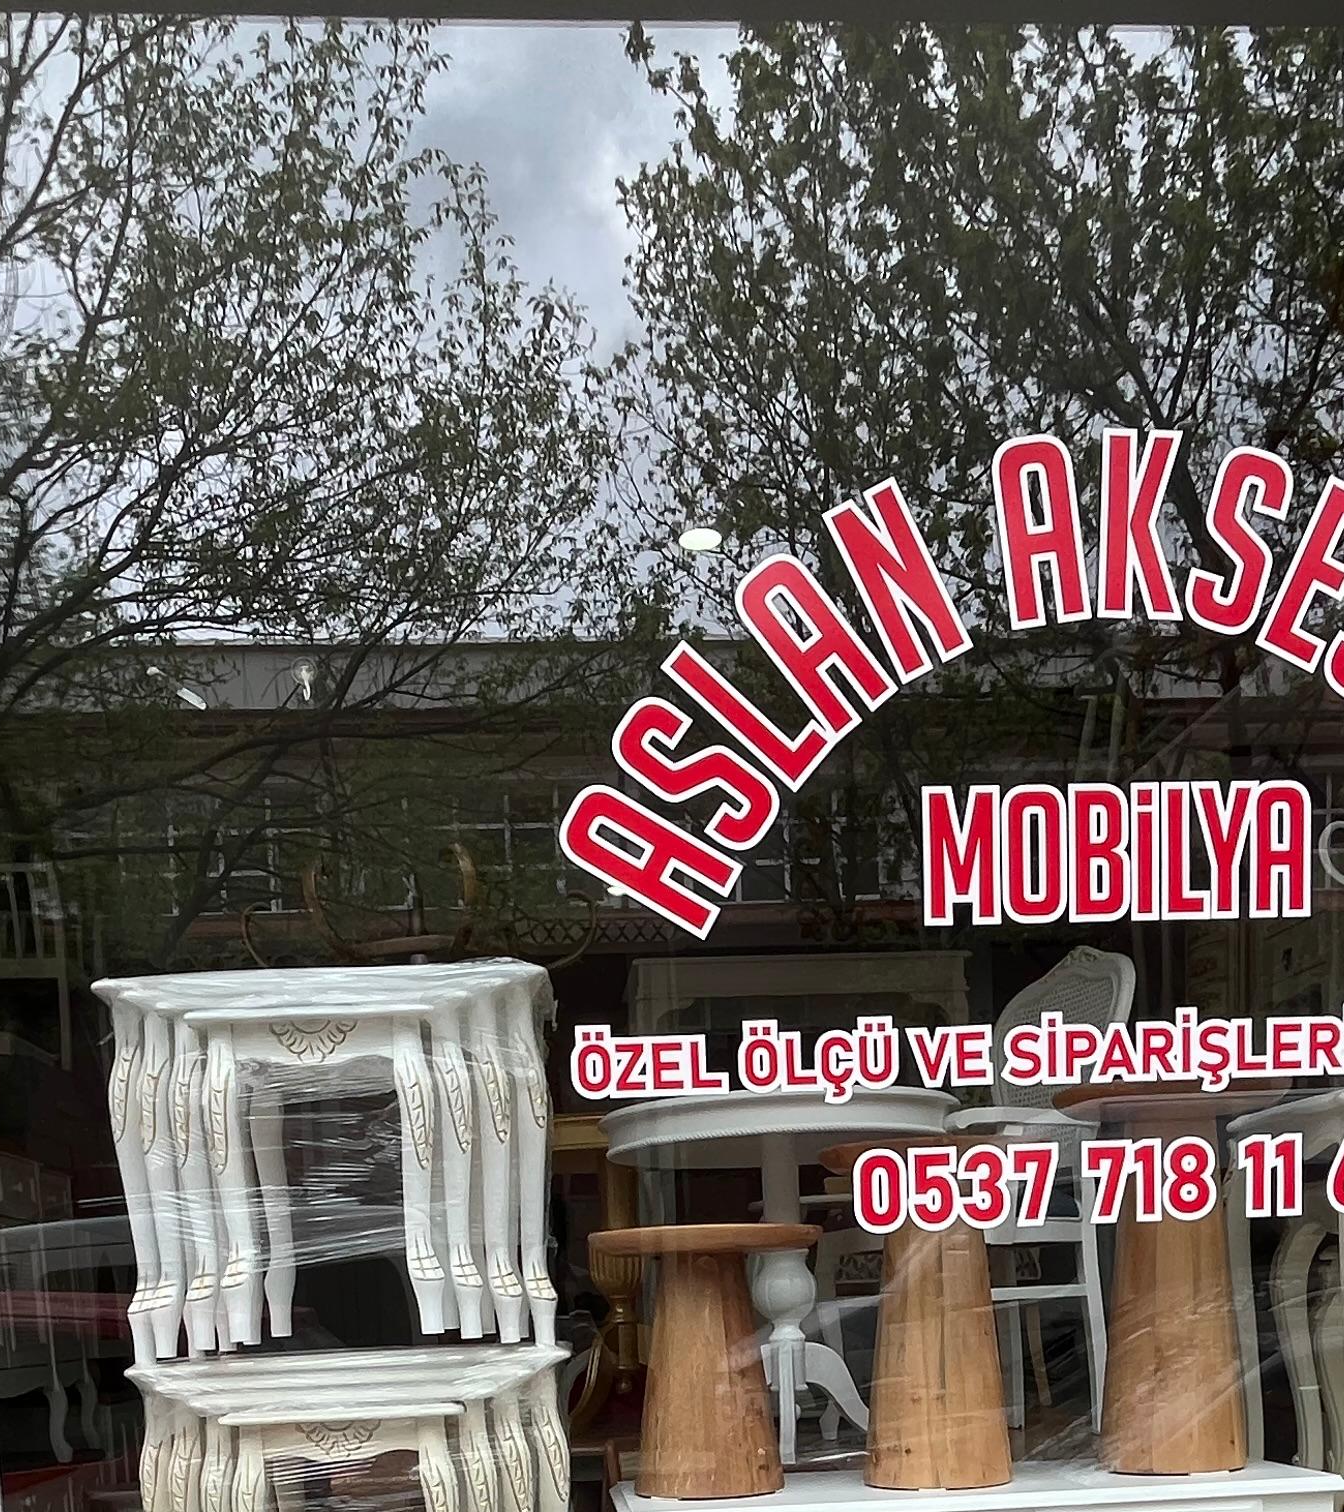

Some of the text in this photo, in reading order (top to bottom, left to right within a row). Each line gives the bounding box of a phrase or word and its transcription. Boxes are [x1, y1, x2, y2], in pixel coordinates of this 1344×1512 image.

[562, 482, 969, 934] ASLAN
[574, 1028, 725, 1096] ÖZEL
[741, 1022, 896, 1101] ÖLÇÜ
[911, 1027, 990, 1084] VE
[856, 1146, 1056, 1230] 0537
[1083, 1140, 1214, 1219] 718
[1239, 1137, 1299, 1214] 11
